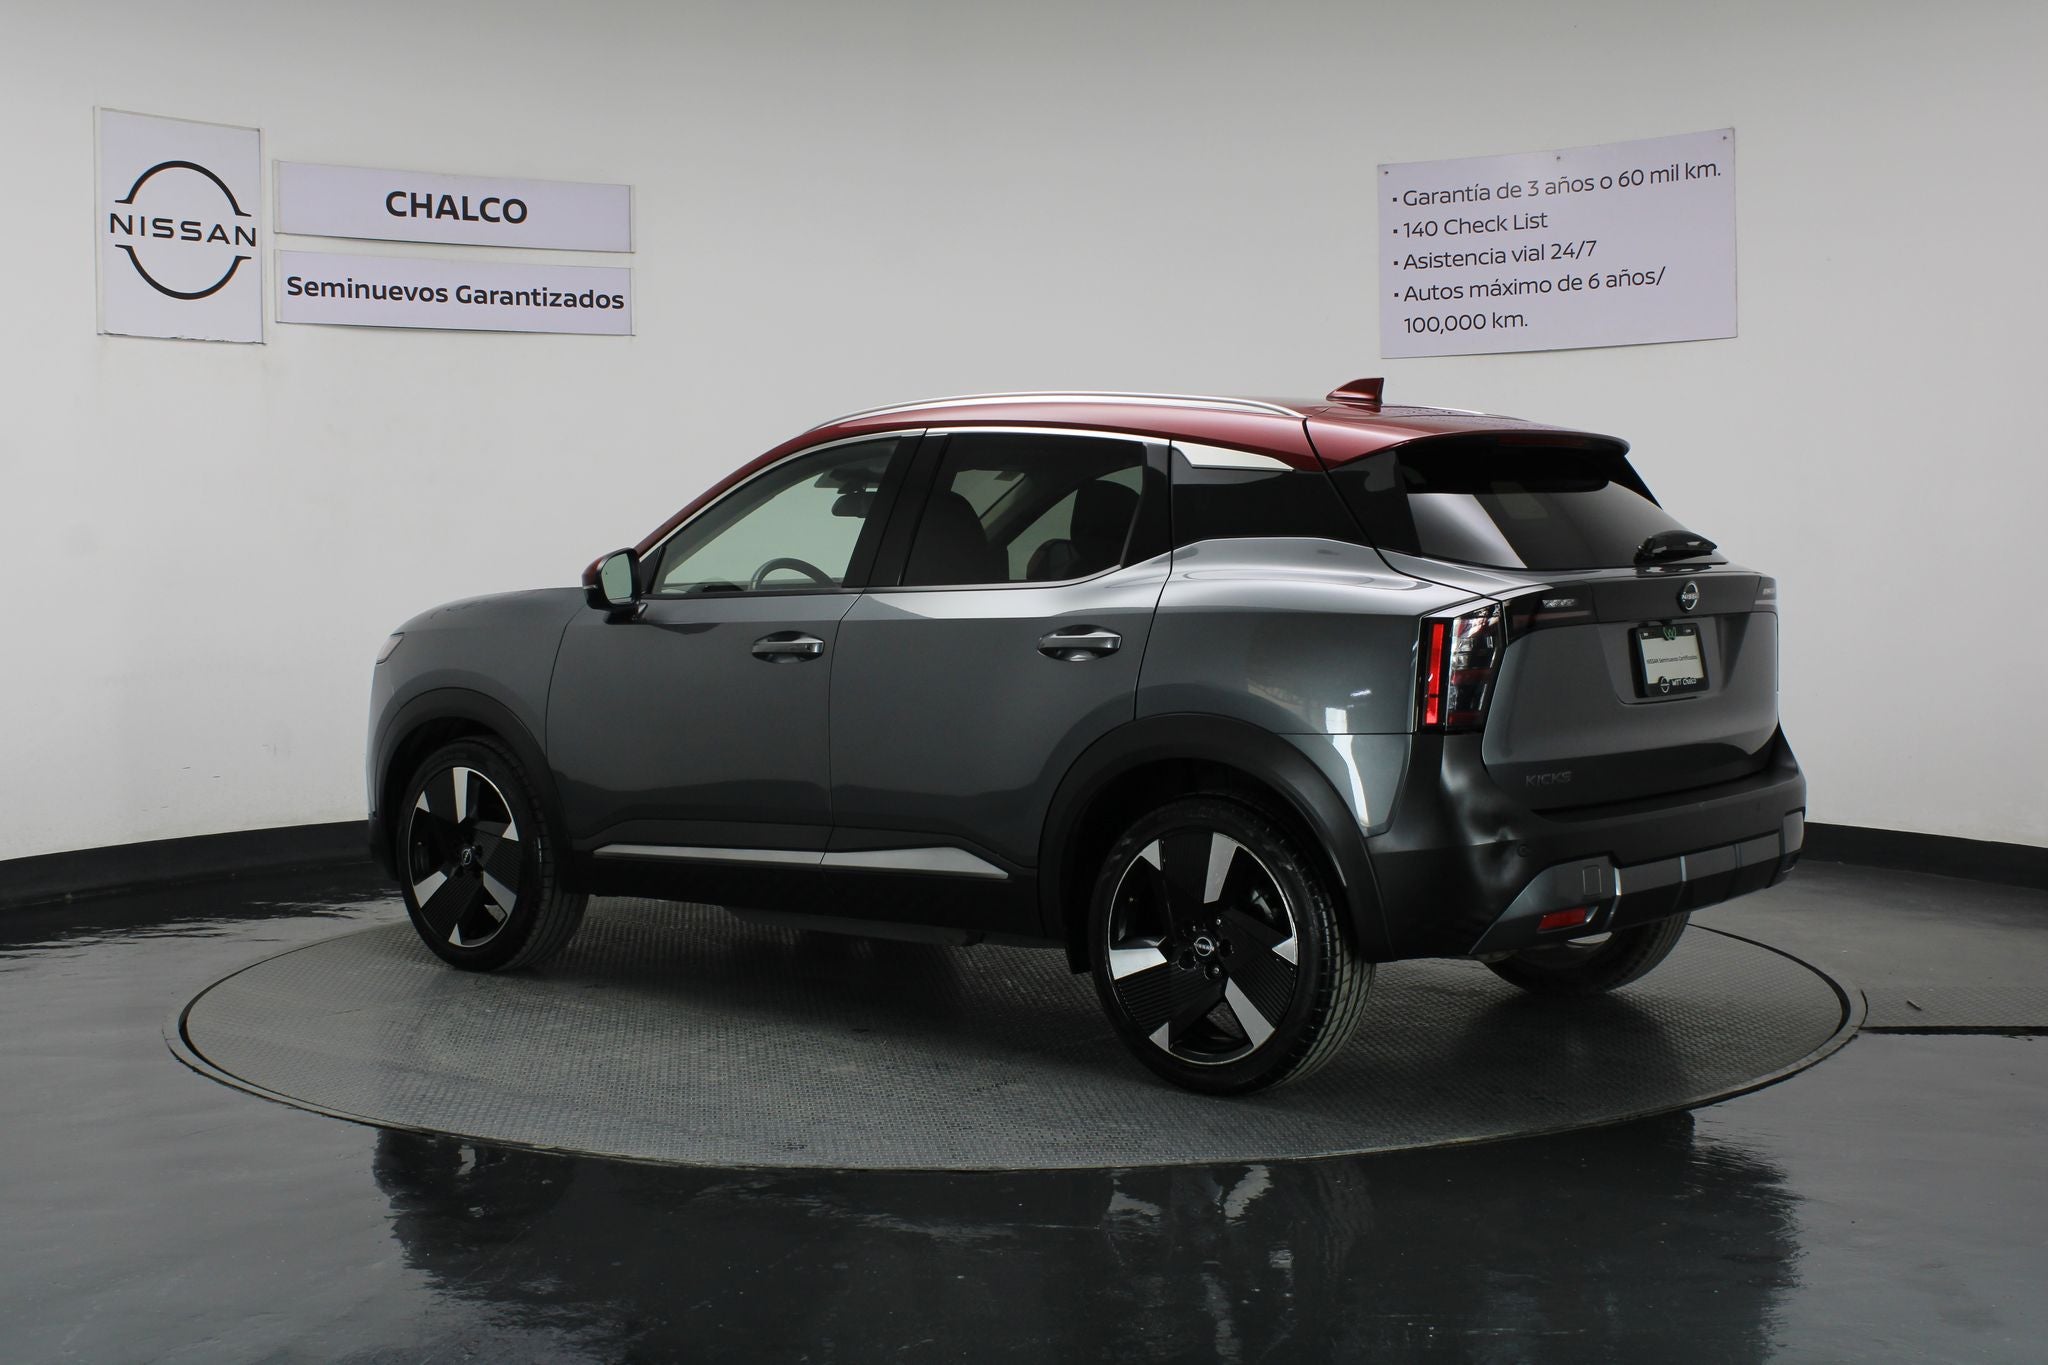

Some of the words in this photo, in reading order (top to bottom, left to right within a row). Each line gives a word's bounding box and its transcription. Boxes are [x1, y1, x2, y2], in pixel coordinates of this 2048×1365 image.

[1403, 183, 1491, 206] Garantía
[1497, 182, 1522, 200] de
[1528, 180, 1539, 197] 3
[1545, 175, 1595, 195] años
[1600, 176, 1613, 190] o
[1619, 169, 1644, 188] 60
[1651, 164, 1679, 184] mil
[1686, 162, 1721, 180] km.
[386, 191, 528, 224] CHALCO
[110, 212, 257, 247] NISSAN
[1403, 221, 1438, 238] 140
[1444, 215, 1508, 235] Check
[1514, 212, 1549, 230] List
[1404, 248, 1507, 270] Asistencia
[1512, 244, 1545, 262] vial
[1551, 240, 1597, 259] 24/7
[287, 276, 449, 303] Seminuevos
[456, 285, 625, 310] Garantizados
[1404, 285, 1464, 301] Autos
[1470, 278, 1553, 298] máximo
[1558, 274, 1583, 291] de
[1589, 273, 1600, 289] 6
[1606, 266, 1666, 288] años/
[1404, 314, 1487, 334] 100,000
[1493, 312, 1529, 328] km.
[1526, 771, 1571, 786] KICKS
